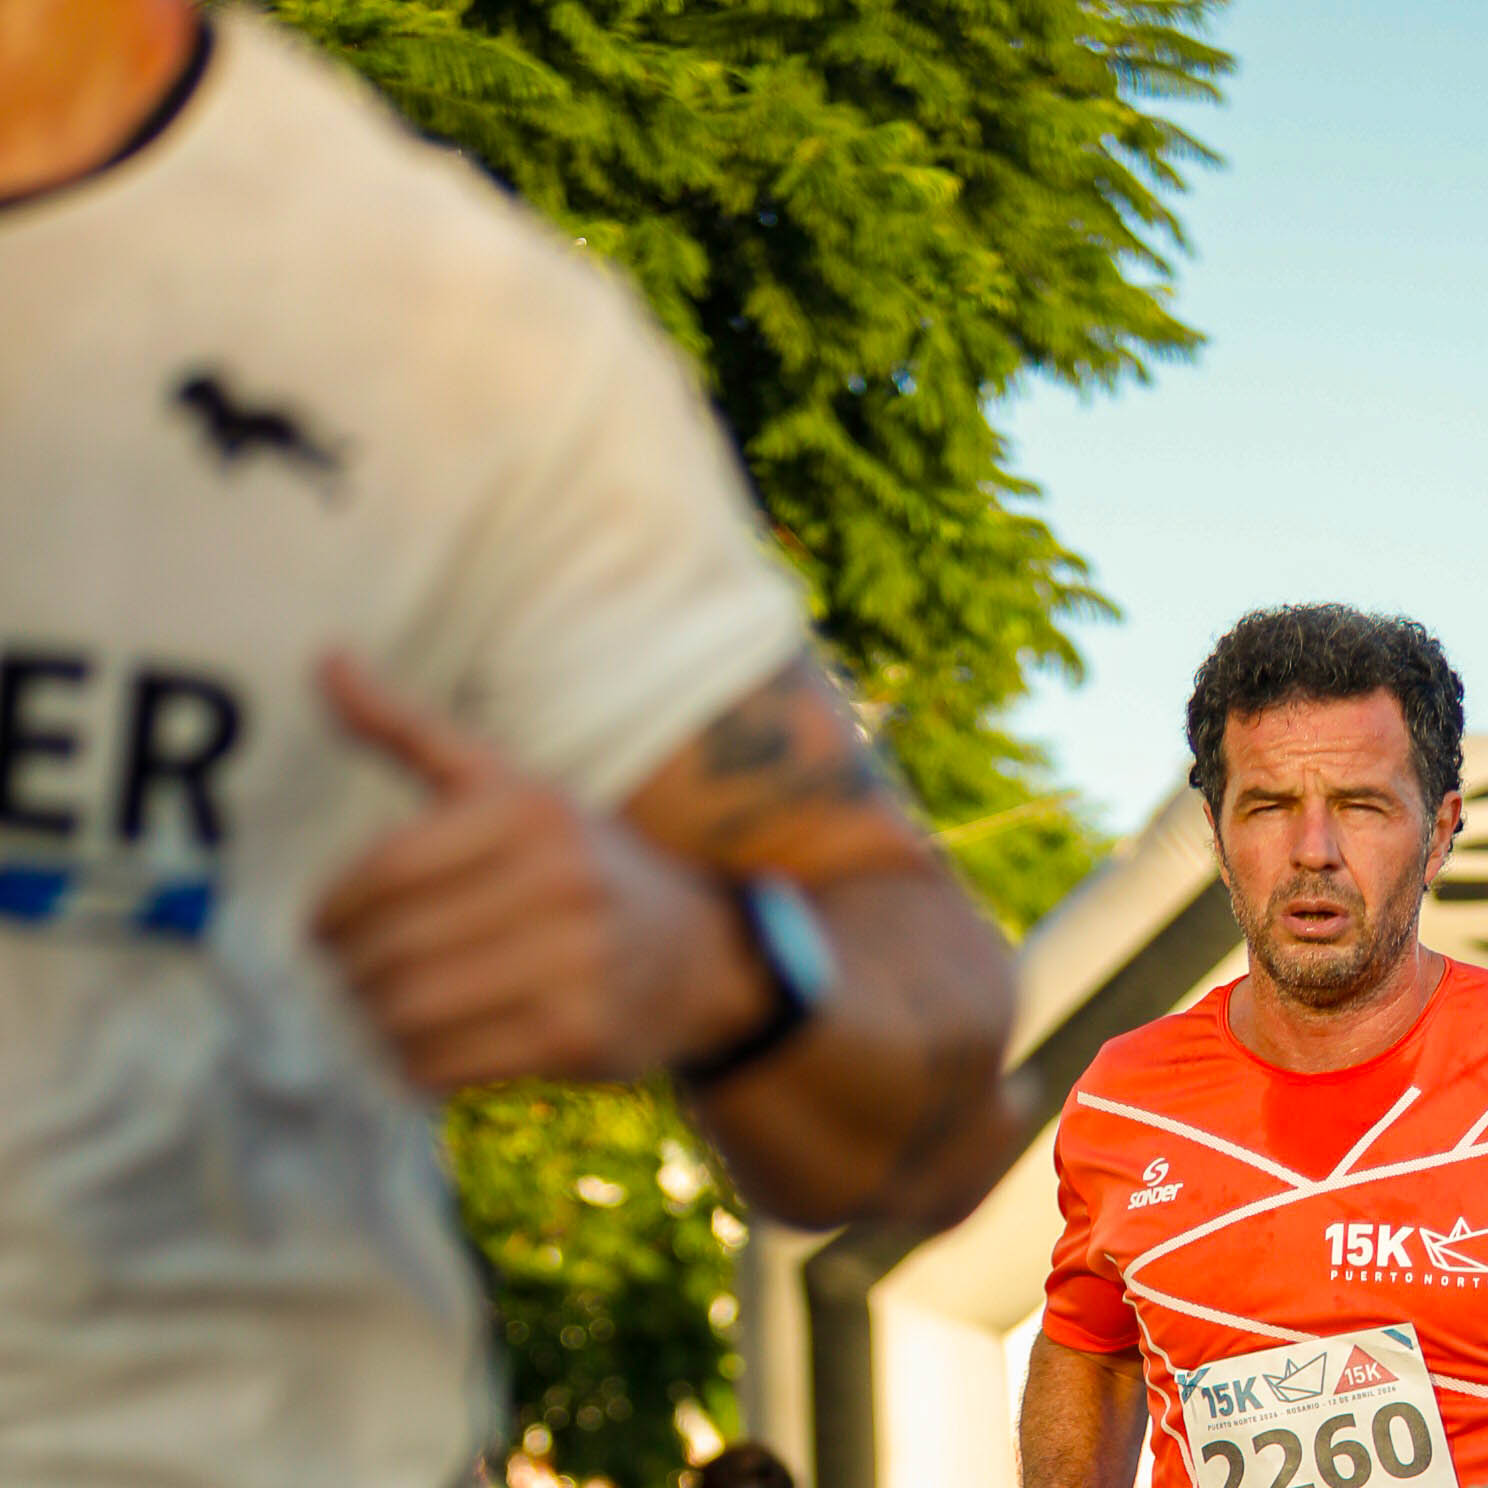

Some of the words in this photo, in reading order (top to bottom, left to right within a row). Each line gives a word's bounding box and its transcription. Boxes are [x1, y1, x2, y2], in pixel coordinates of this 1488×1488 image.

[1325, 1223, 1415, 1268] 15K
[1330, 1269, 1414, 1284] PUERTO
[1344, 1361, 1383, 1387] 15K
[1201, 1376, 1265, 1419] 15K
[1207, 1421, 1232, 1432] PUERTO
[1233, 1416, 1258, 1427] NORTE
[1259, 1411, 1279, 1423] 2026
[1286, 1402, 1320, 1416] ROSARIO
[1351, 1390, 1375, 1402] ABRIL
[1377, 1385, 1397, 1397] 2026
